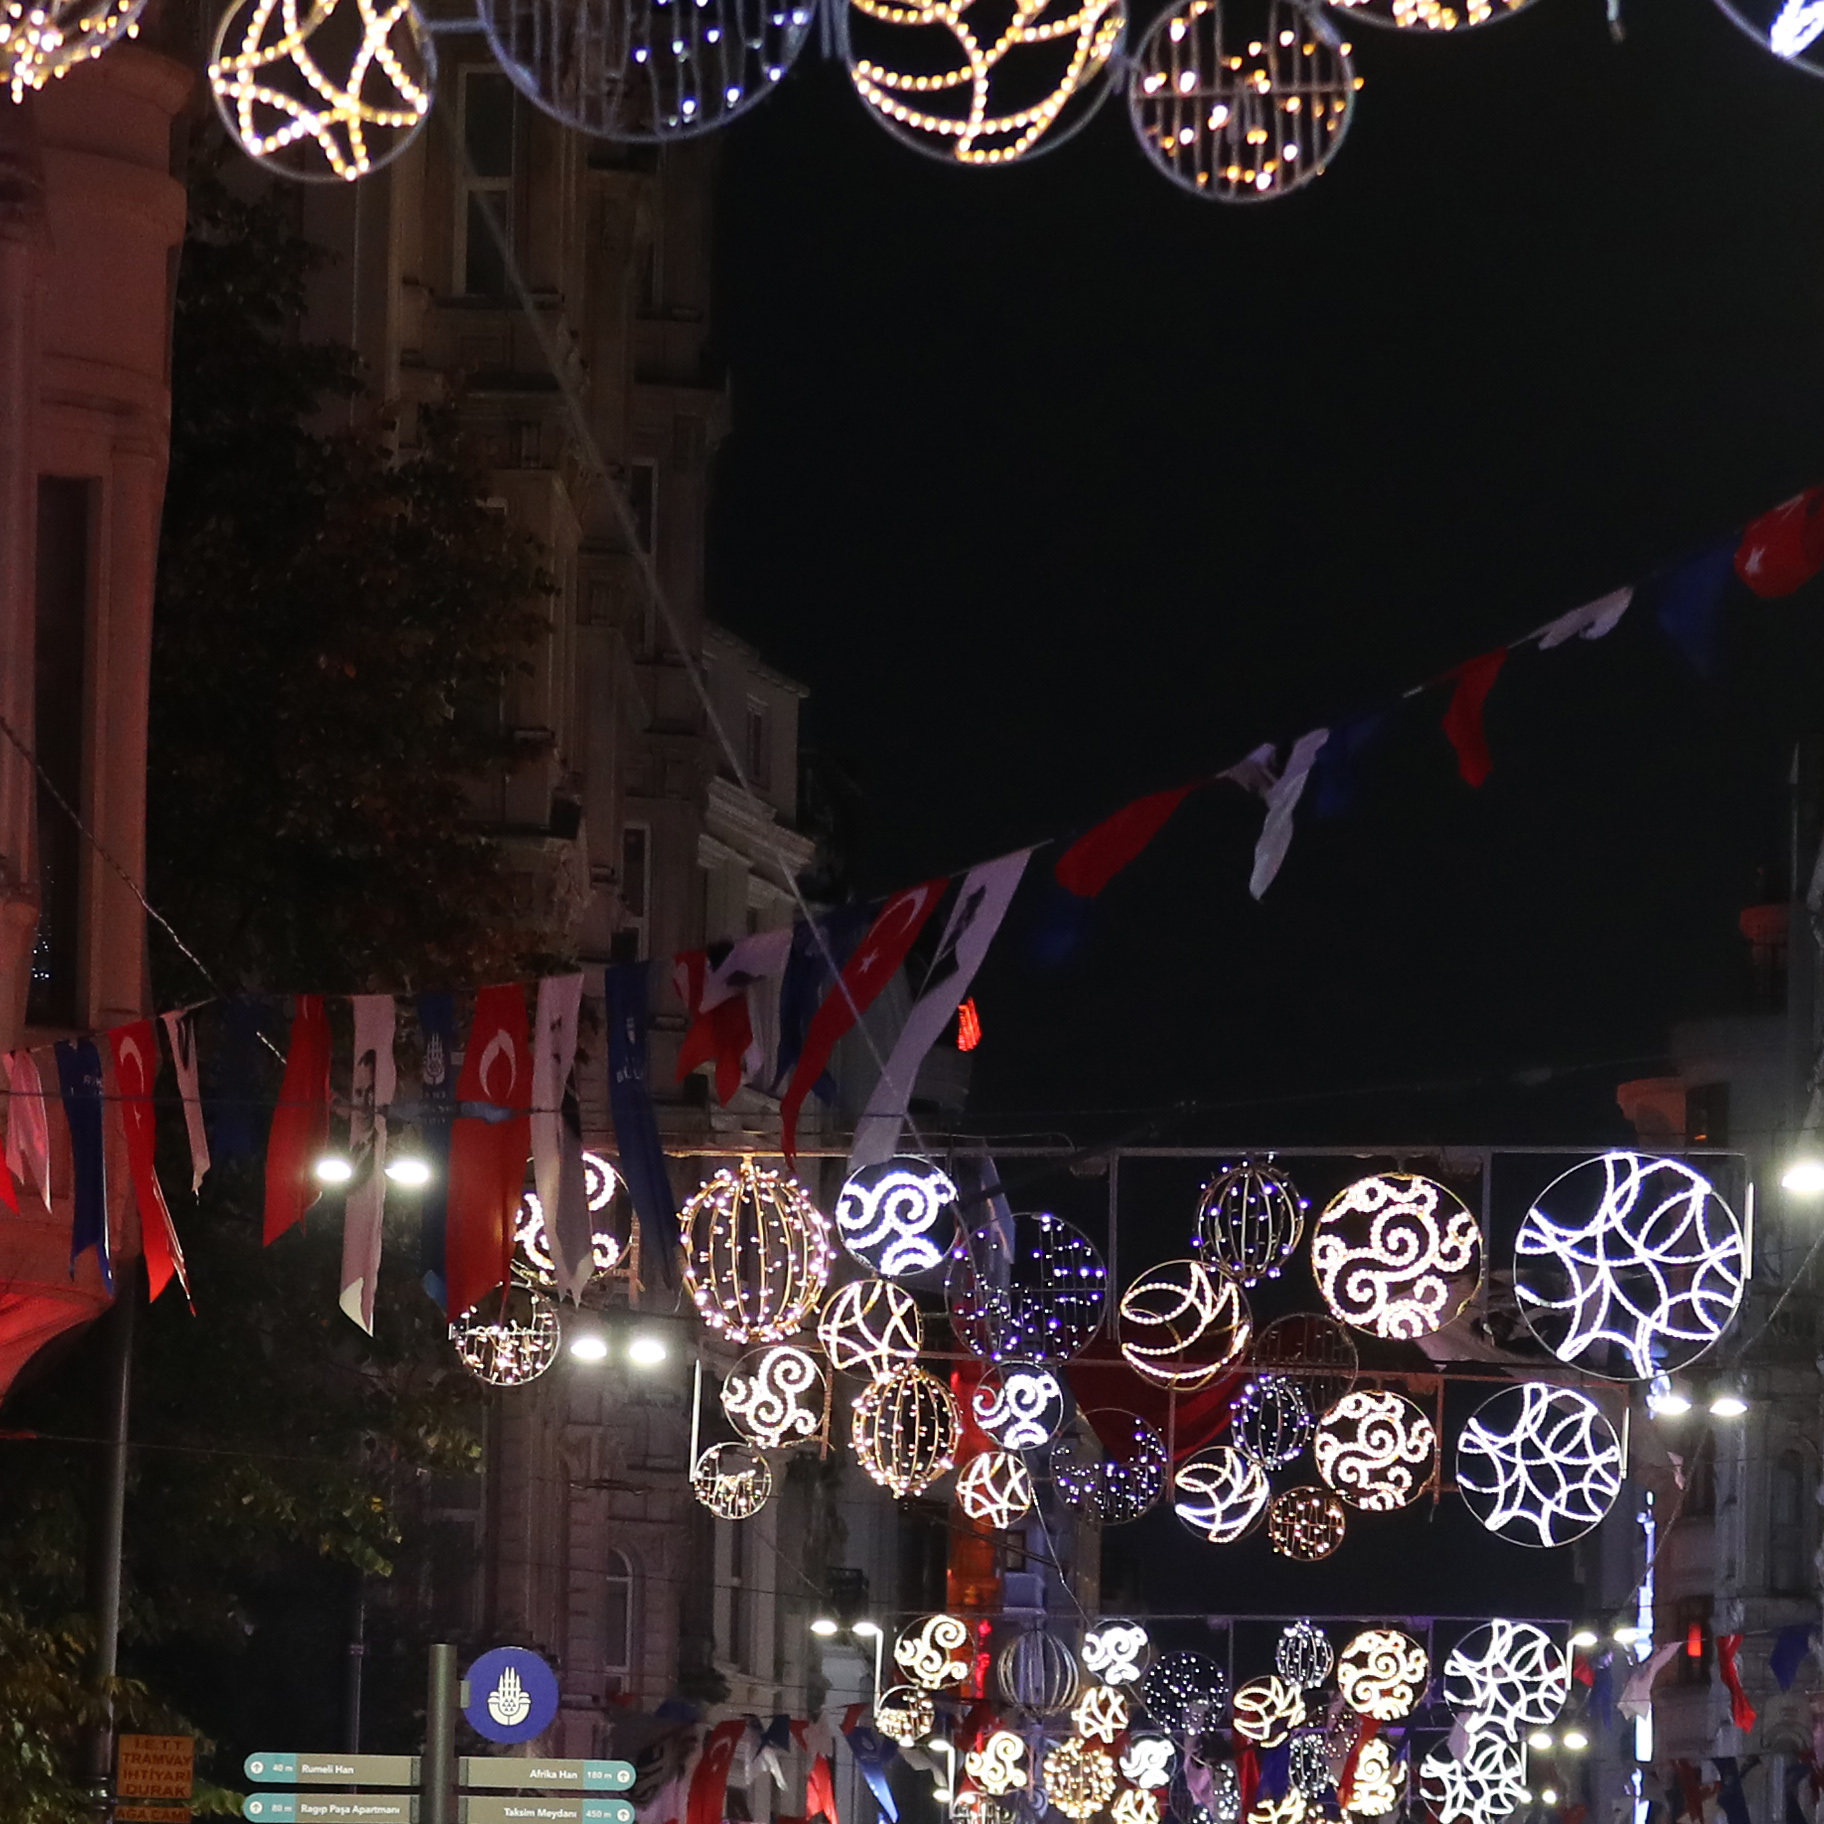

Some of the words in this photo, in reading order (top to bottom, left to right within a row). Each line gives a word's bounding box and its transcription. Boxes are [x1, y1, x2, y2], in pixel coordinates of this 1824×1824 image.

[122, 1752, 193, 1766] TRAMVAY
[301, 1764, 334, 1774] Rumeli
[335, 1765, 354, 1774] Han
[529, 1769, 557, 1779] Afrika
[559, 1770, 578, 1779] Han
[126, 1784, 186, 1796] DURAK
[329, 1805, 350, 1816] Paşa
[352, 1805, 400, 1815] Apartmanı
[503, 1807, 535, 1817] Taksim
[537, 1808, 577, 1820] Meydanı
[585, 1810, 602, 1818] 450
